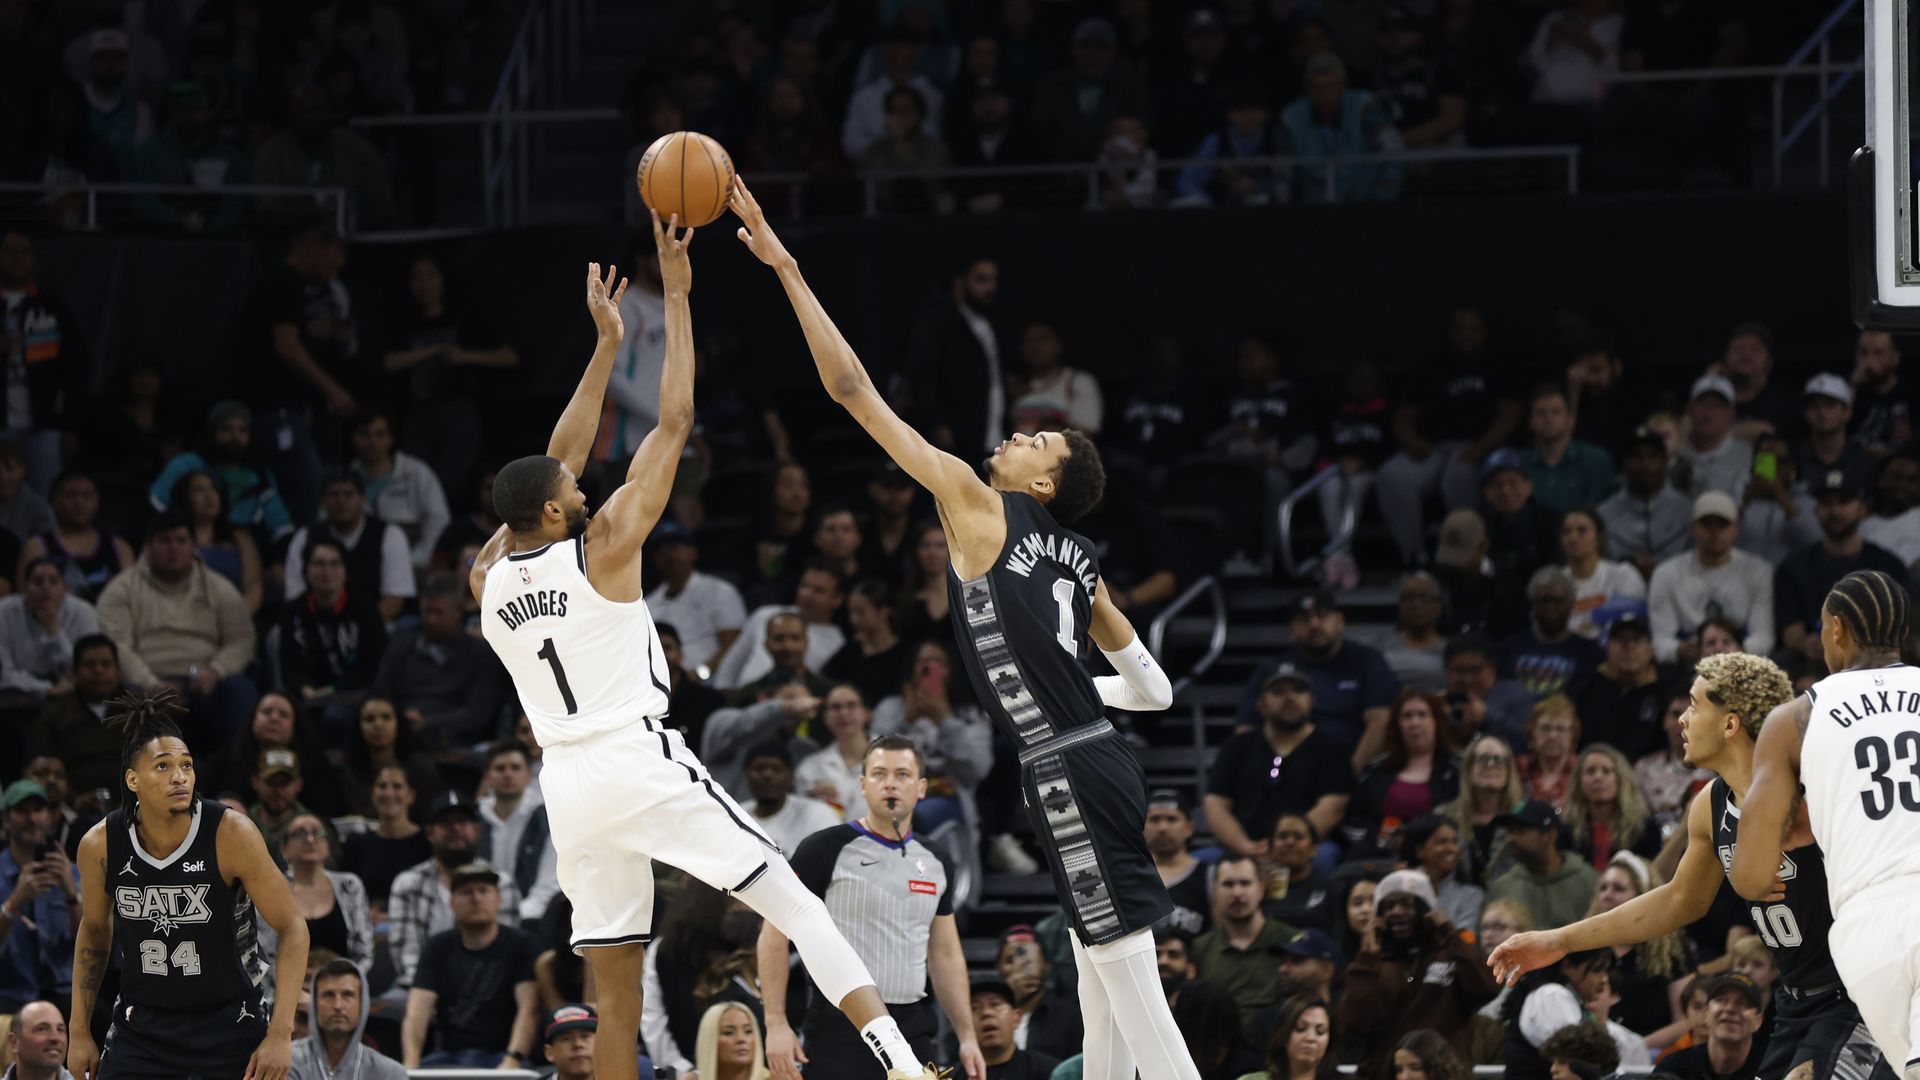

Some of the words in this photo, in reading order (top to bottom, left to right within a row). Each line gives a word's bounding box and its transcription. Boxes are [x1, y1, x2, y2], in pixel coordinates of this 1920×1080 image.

[496, 589, 568, 631] BRIDGES
[1052, 577, 1078, 659] 1
[537, 637, 578, 716] 1
[1829, 690, 1920, 729] CLAXTO
[1854, 730, 1920, 821] 33
[182, 860, 207, 873] Self.
[115, 884, 213, 925] SATX
[1751, 903, 1803, 948] 10
[139, 939, 202, 977] 24
